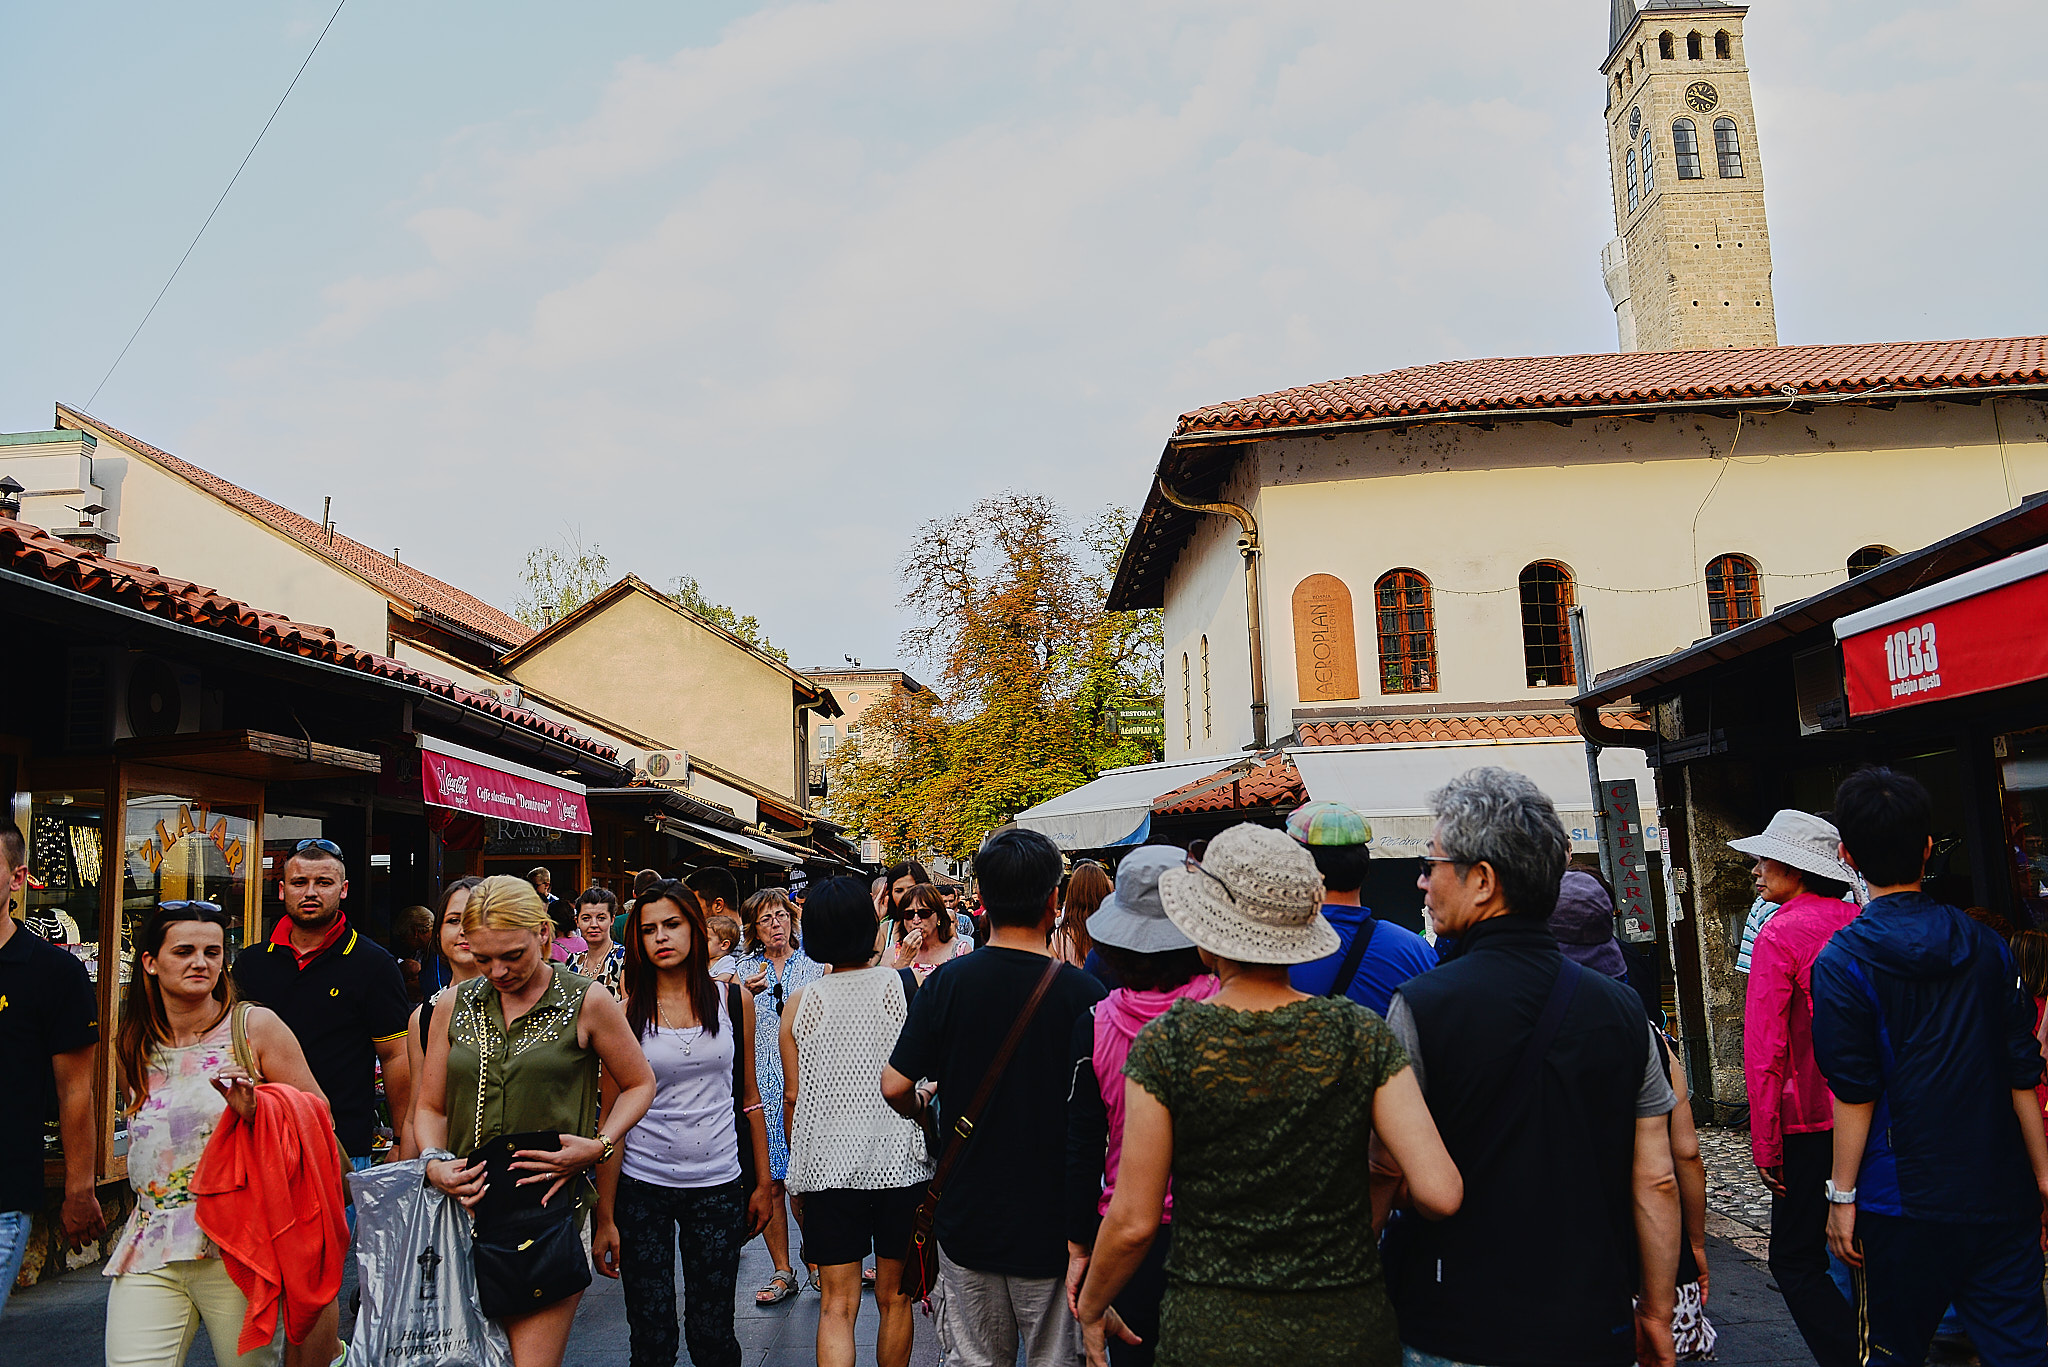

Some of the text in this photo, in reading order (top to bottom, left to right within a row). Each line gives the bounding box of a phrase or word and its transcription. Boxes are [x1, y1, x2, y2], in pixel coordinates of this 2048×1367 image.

[1310, 604, 1334, 695] AEROPLAN
[1884, 622, 1938, 682] 1033
[1918, 672, 1941, 692] mjesto
[1120, 726, 1153, 735] AEROPLAN
[476, 786, 491, 803] Caffe
[140, 801, 243, 876] ZLATAR
[1611, 785, 1646, 916] CVJEĆARA
